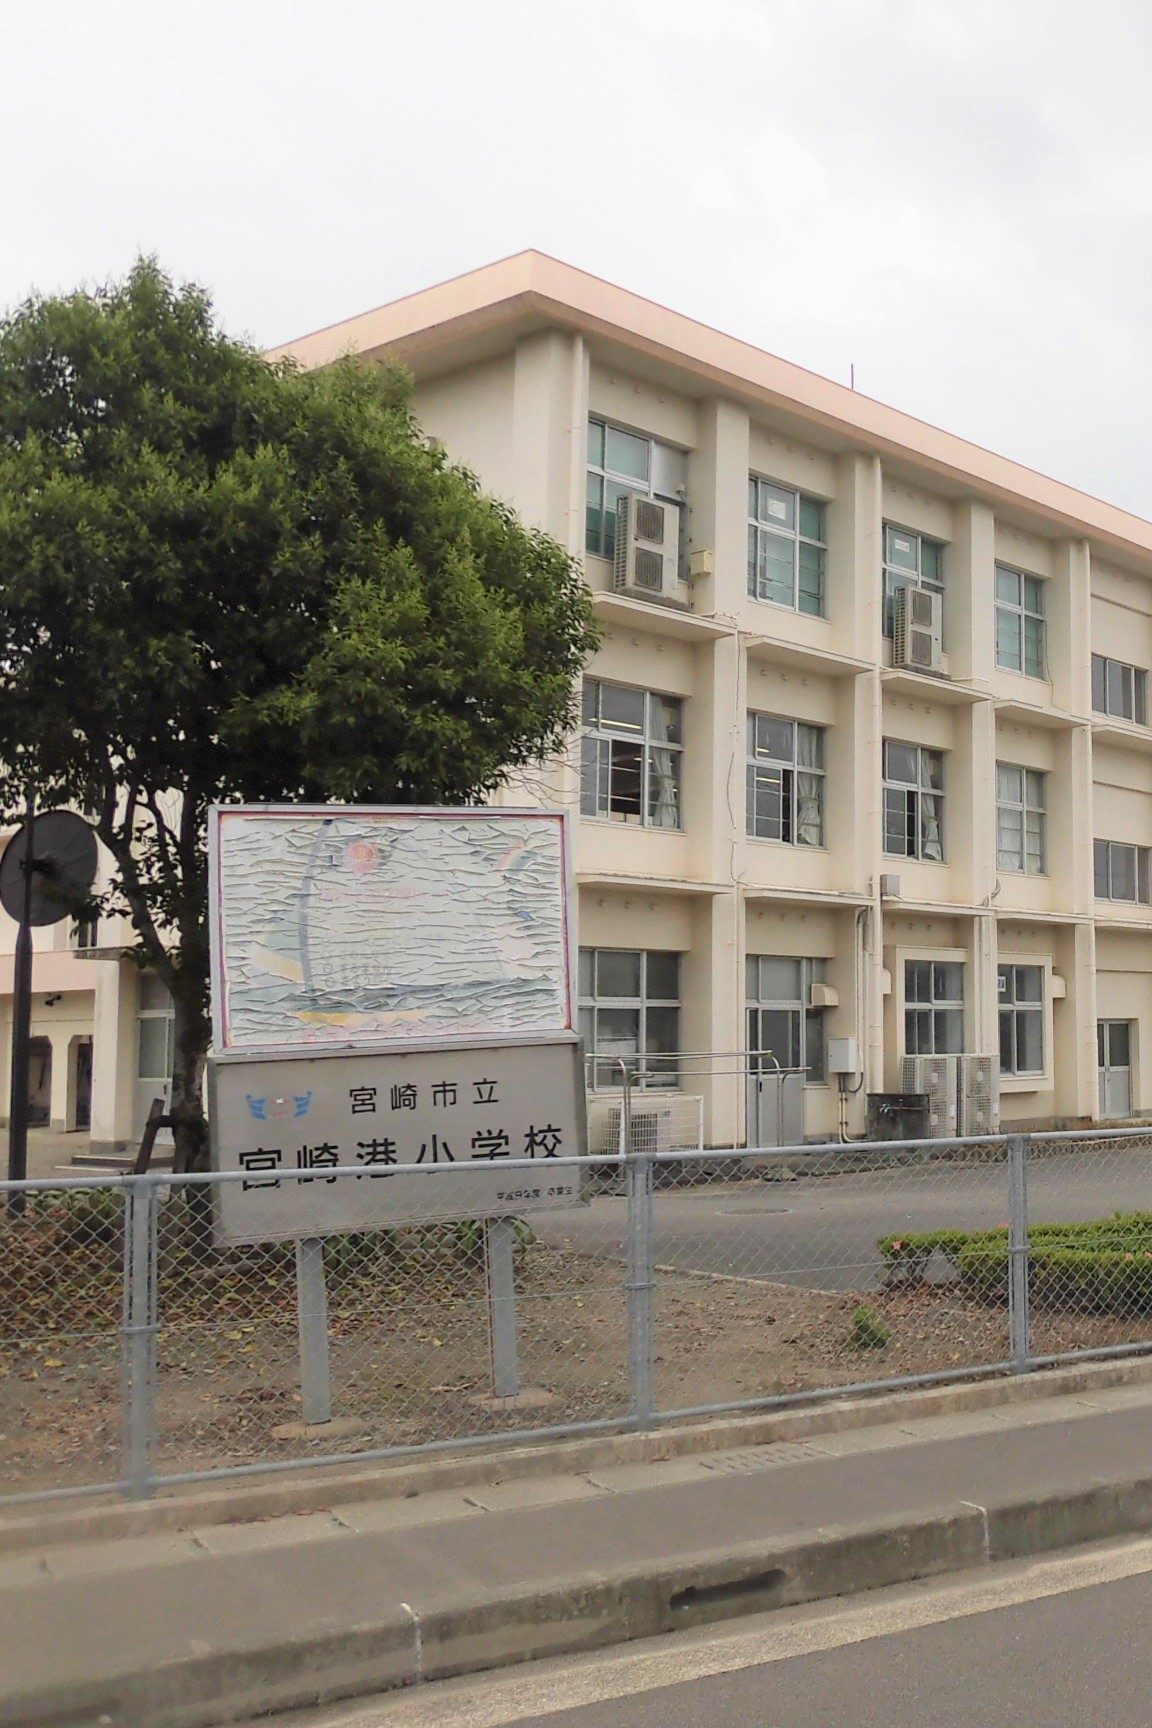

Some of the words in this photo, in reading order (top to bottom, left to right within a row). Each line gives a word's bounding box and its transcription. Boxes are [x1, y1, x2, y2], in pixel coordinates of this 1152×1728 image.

[349, 1078, 500, 1115] 宮崎市立
[238, 1123, 564, 1192] 宮崎港小学校
